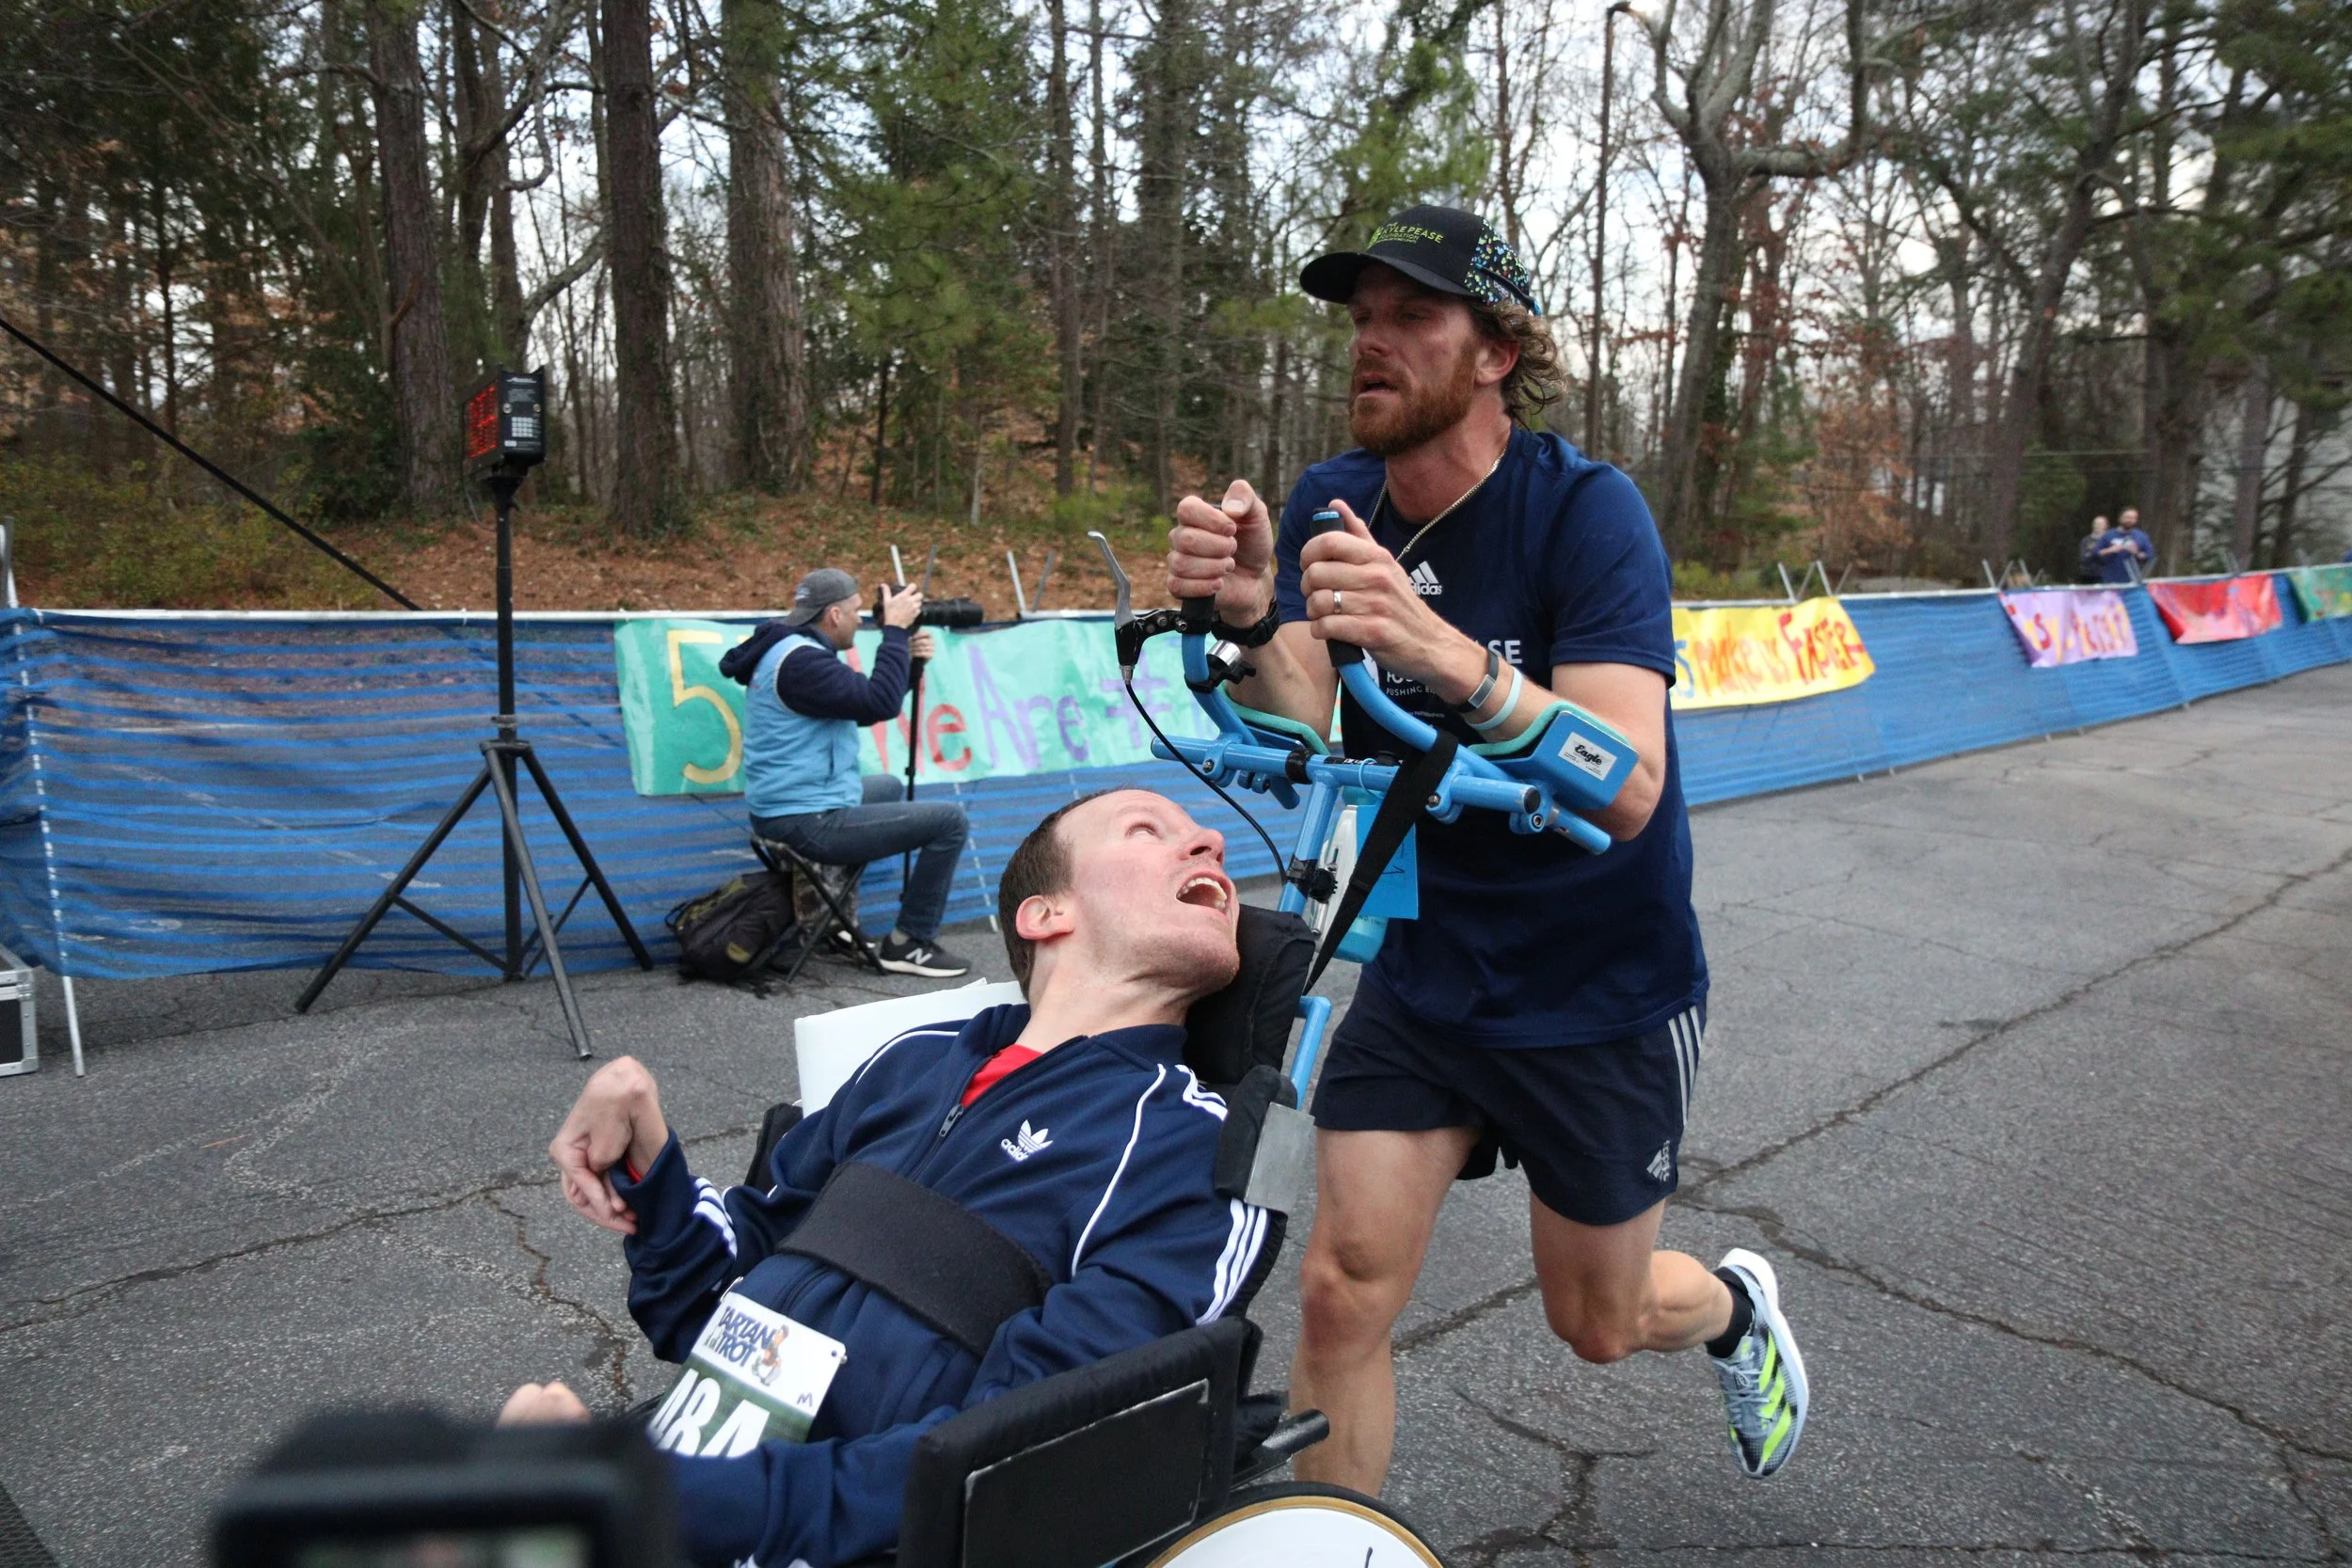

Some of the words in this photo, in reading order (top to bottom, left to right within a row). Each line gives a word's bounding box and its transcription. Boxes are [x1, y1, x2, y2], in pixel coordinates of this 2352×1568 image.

[1407, 227, 1444, 244] PEASE
[1410, 582, 1442, 595] didas
[1386, 686, 1422, 696] PUSHING
[967, 644, 1089, 769] Are
[1574, 744, 1602, 766] Eagle
[714, 1329, 758, 1368] TROT
